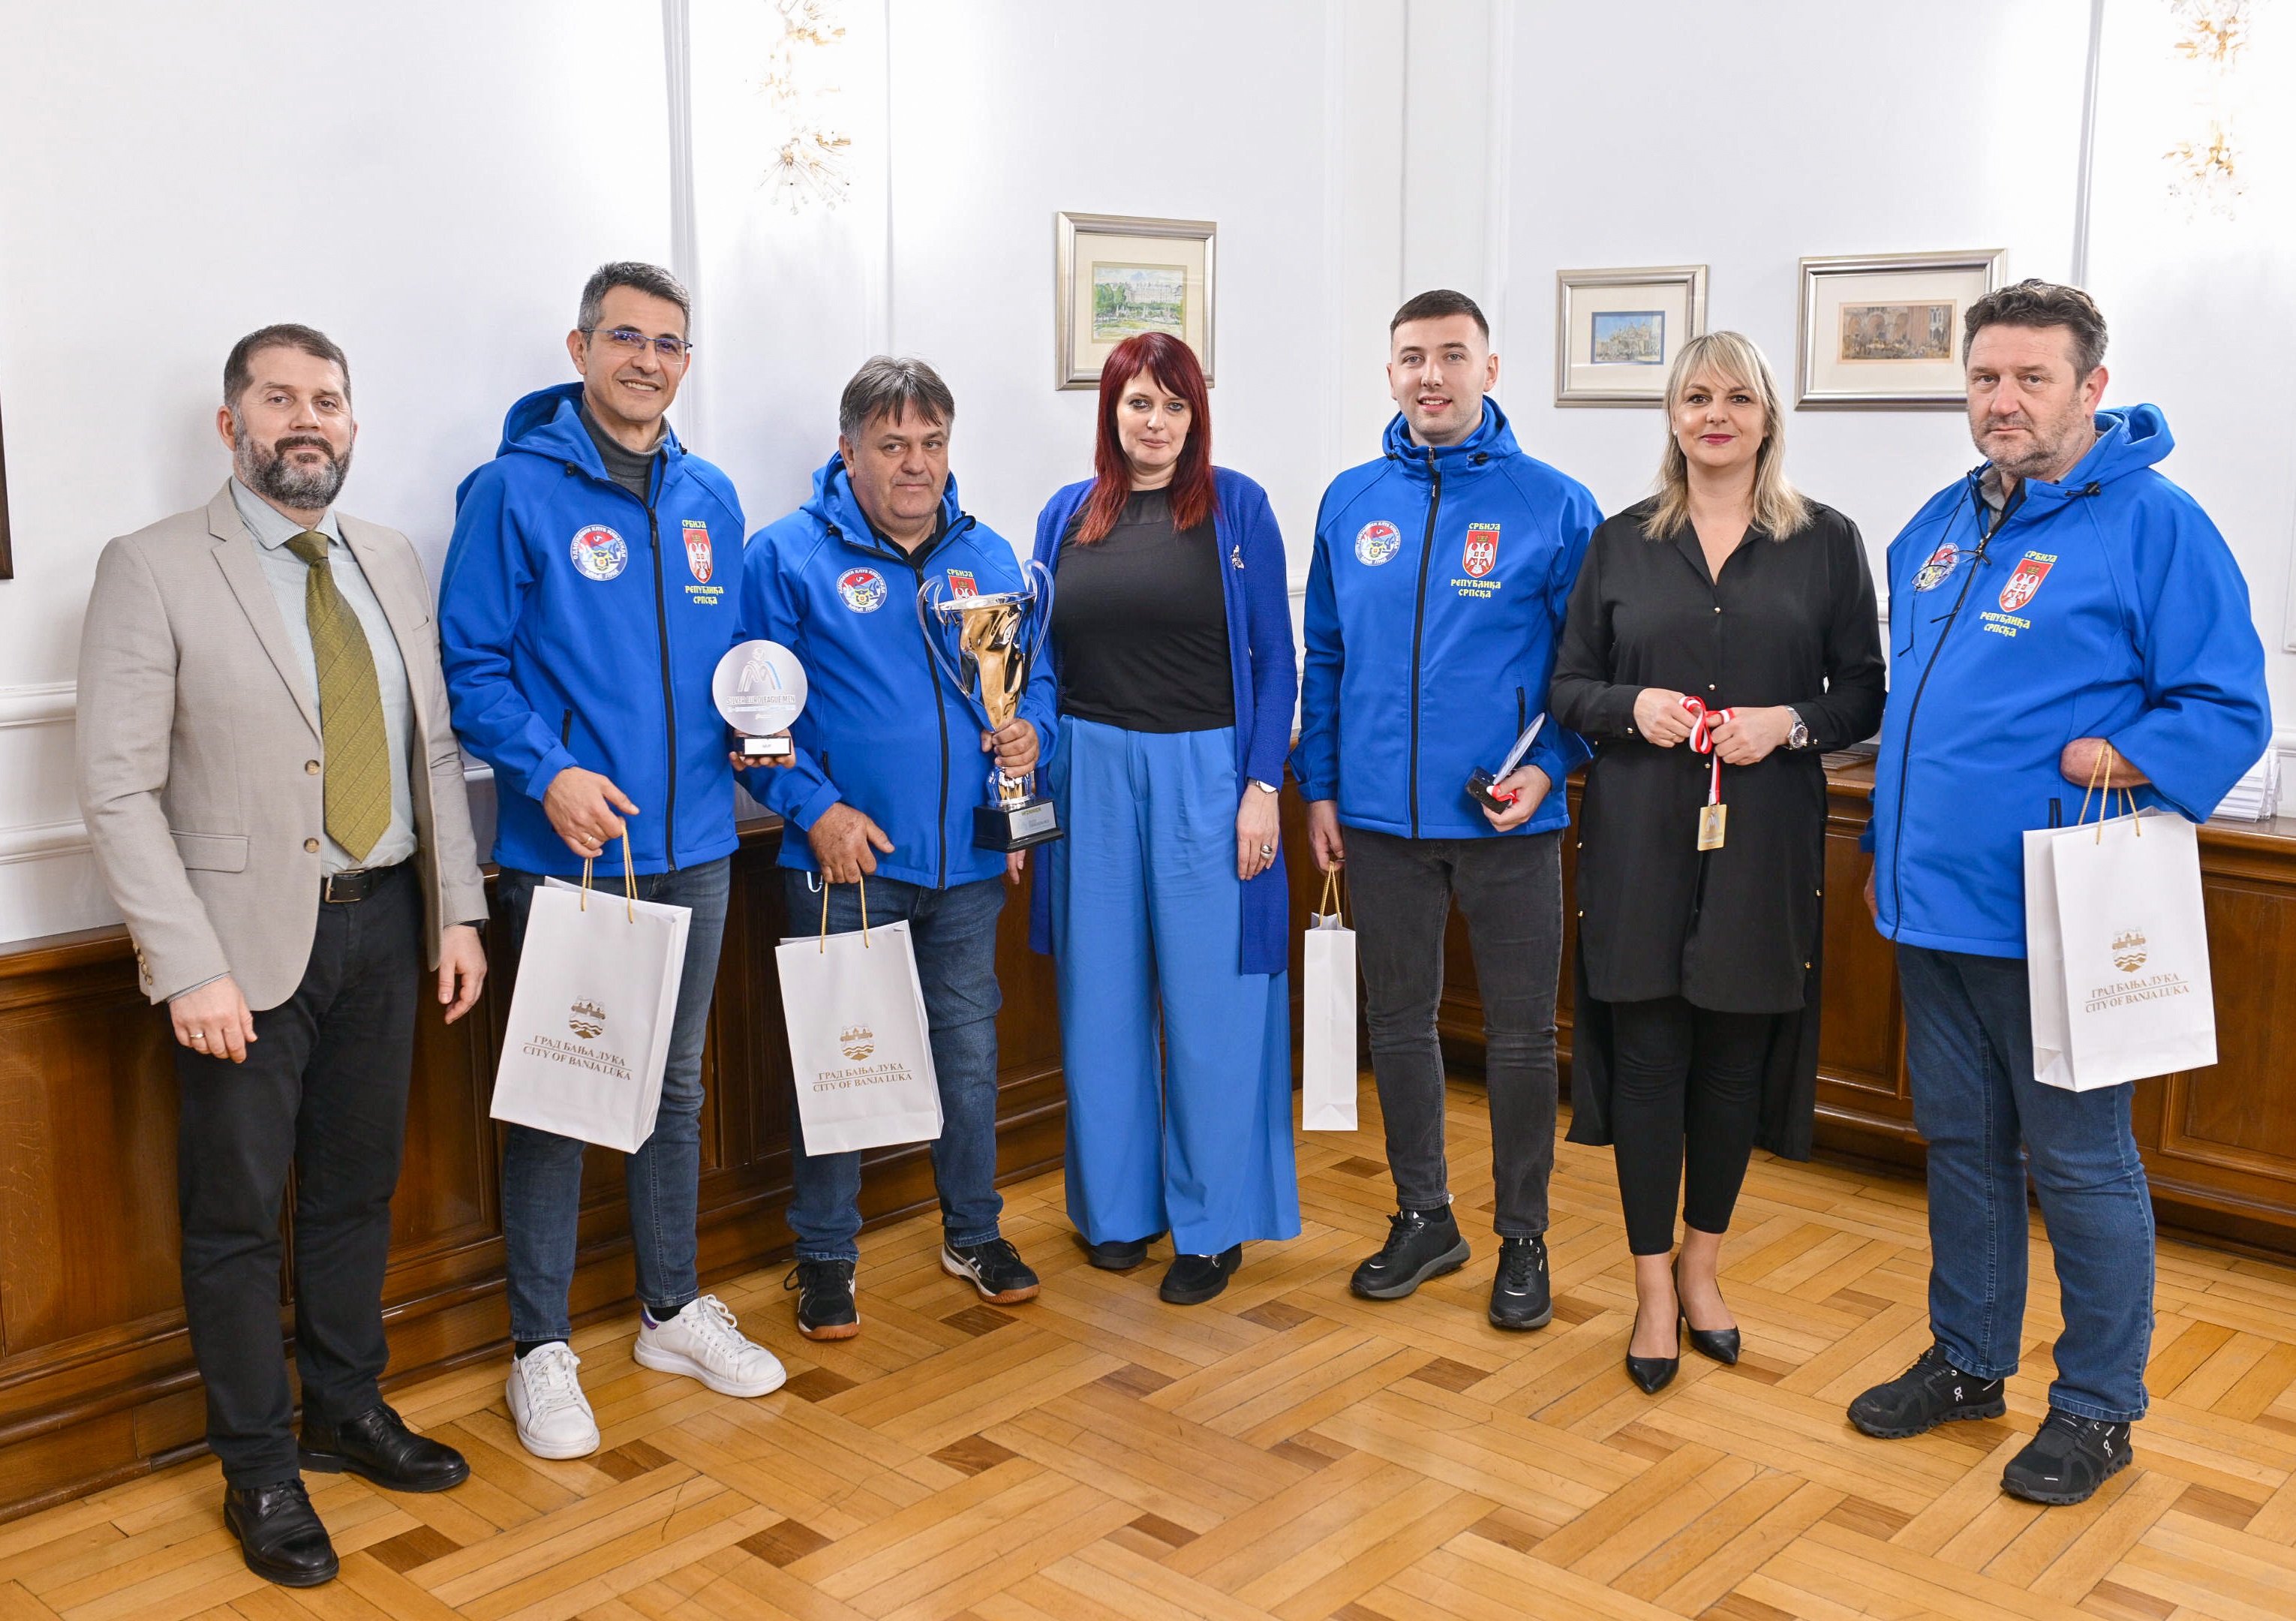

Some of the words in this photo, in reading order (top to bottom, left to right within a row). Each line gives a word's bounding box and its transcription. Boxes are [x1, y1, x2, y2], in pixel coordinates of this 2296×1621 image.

[681, 519, 707, 528] СРБИЈА
[1468, 522, 1501, 531] СРБИЈА
[2024, 550, 2058, 563] СРБИЈА
[947, 568, 974, 578] СРБИЈА
[684, 585, 724, 596] РЕПУБЛИКА
[1450, 579, 1501, 590] РЕПУБЛИКА
[1458, 588, 1492, 599] СРПСКА
[693, 596, 718, 606] СРПСКА
[1979, 612, 2031, 630] РЕПУБЛИКА
[1983, 623, 2017, 637] СРПСКА
[2091, 985, 2115, 998] ГРАД
[2117, 979, 2147, 992] БАЊА
[2148, 973, 2180, 986] ЛУКА
[2085, 1000, 2108, 1013] CITY
[2109, 998, 2124, 1007] OF
[2125, 991, 2158, 1004] BANJA
[2159, 984, 2190, 997] LUKA
[533, 1035, 561, 1048] ГРАД
[563, 1042, 594, 1057] БАЊА
[596, 1051, 625, 1066] ЛУКА
[523, 1045, 550, 1058] CITY
[551, 1052, 567, 1063] OF
[568, 1056, 601, 1072] BANJA
[603, 1065, 632, 1081] LUKA
[819, 1070, 843, 1081] ГРАД
[846, 1066, 874, 1077] БАЊА
[876, 1063, 904, 1073] ЛУКА
[813, 1081, 837, 1093] CITY
[838, 1079, 853, 1089] OF
[854, 1076, 884, 1087] BANJA
[885, 1073, 912, 1083] LUKA
